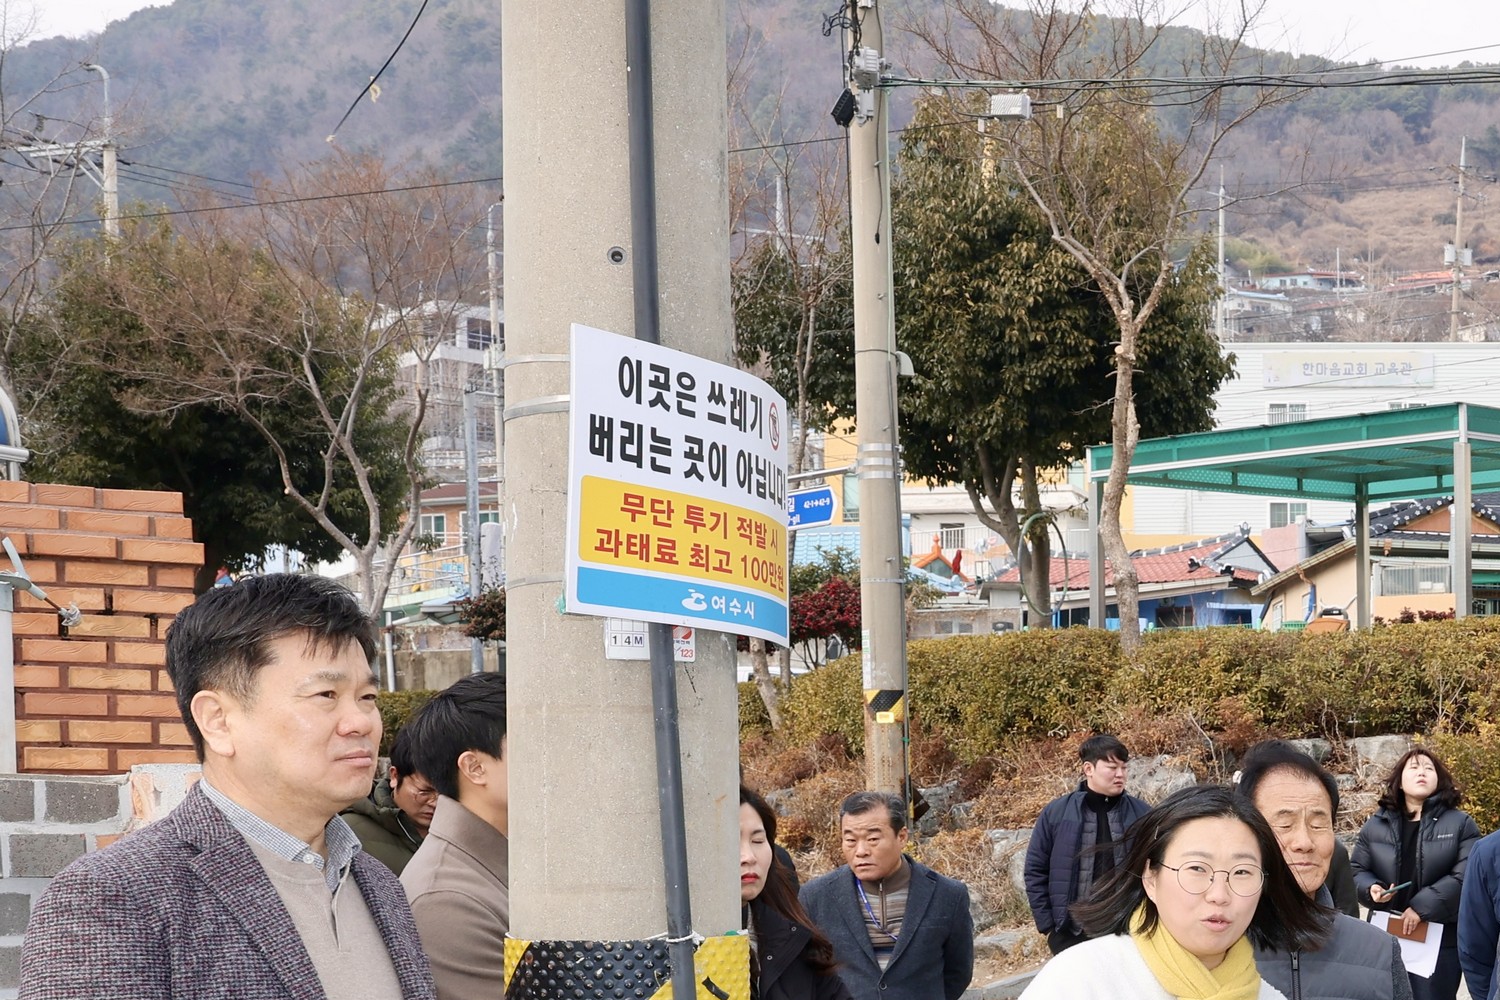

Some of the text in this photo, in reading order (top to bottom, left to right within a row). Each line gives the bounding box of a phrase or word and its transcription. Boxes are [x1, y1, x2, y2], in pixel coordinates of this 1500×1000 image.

[618, 355, 764, 440] 이곳은 쓰레기
[1302, 361, 1413, 376] 한마음교회 교육관
[588, 413, 787, 511] 버리는 곳이 아닙니다!
[620, 492, 779, 556] 무단 투기 적발 시
[594, 528, 785, 593] 과태료 최고 100만원
[711, 596, 755, 620] 여수시
[680, 648, 694, 658] 123
